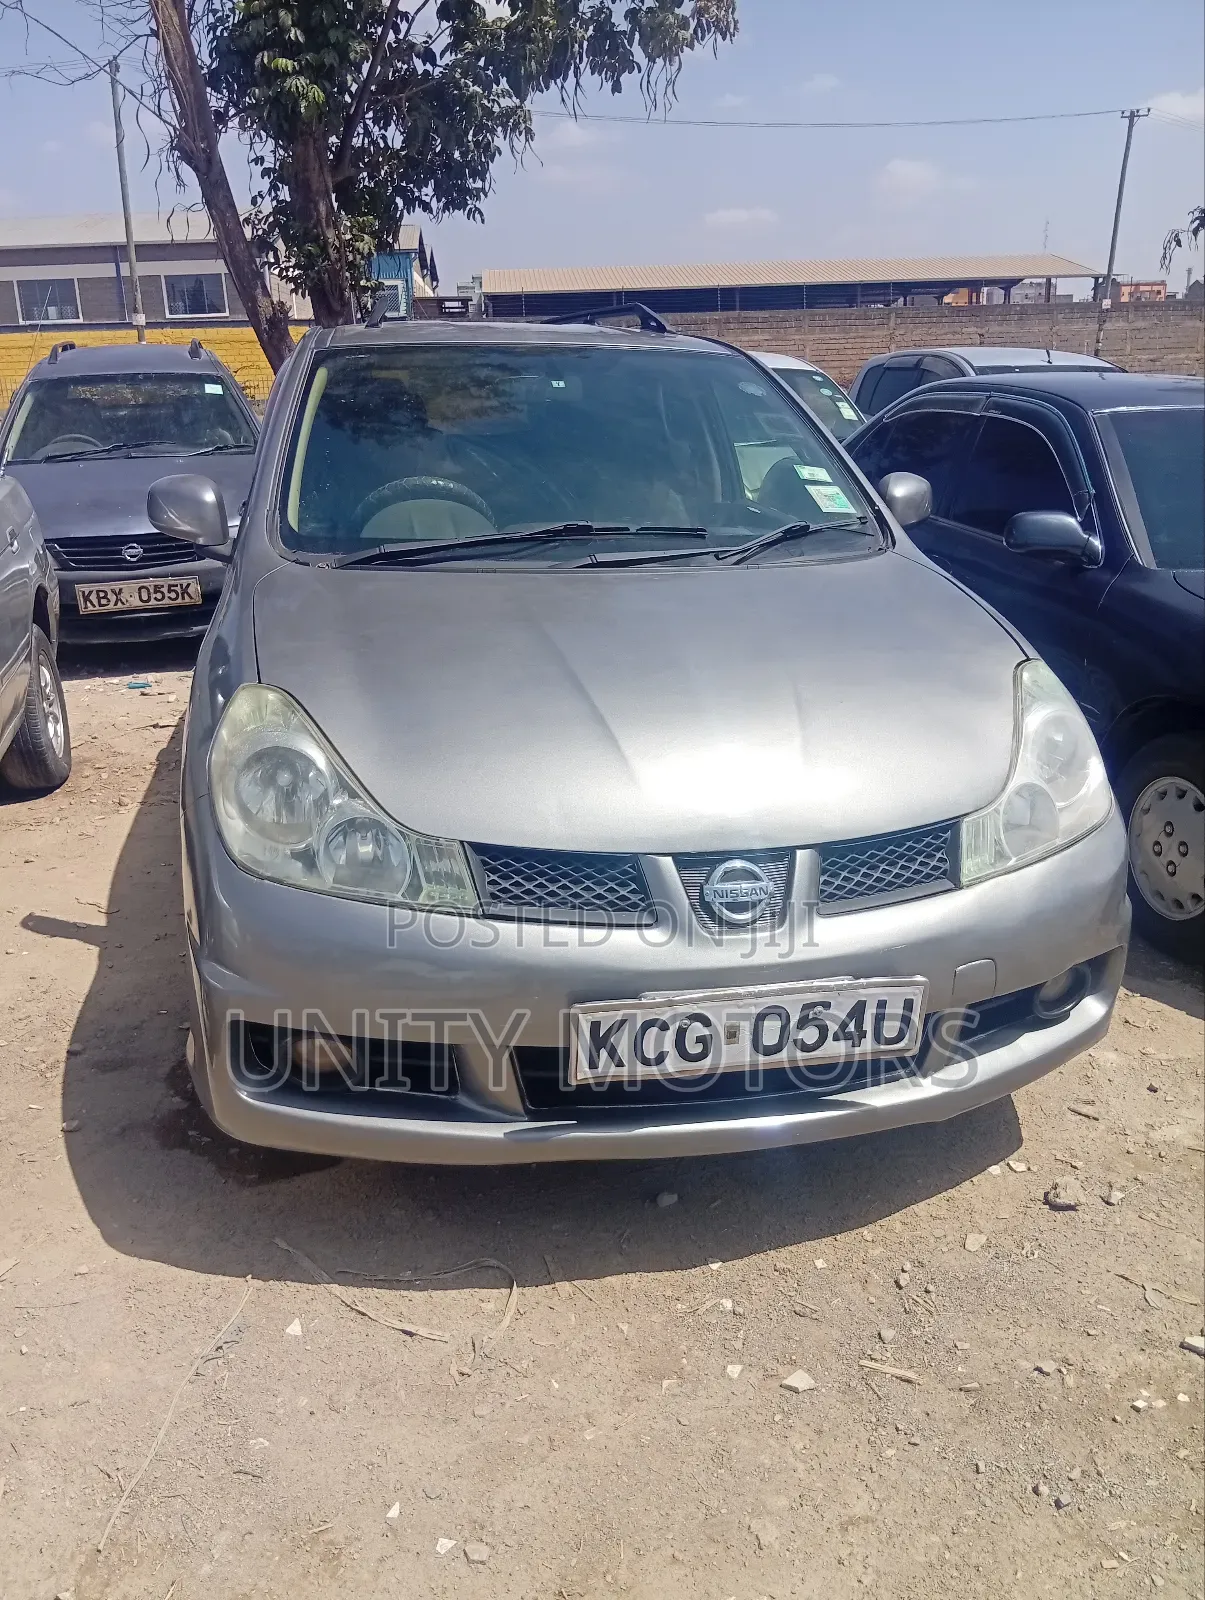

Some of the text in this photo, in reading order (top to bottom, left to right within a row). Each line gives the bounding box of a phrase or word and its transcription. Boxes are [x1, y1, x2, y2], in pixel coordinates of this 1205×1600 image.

[81, 583, 194, 610] KBX 055K
[713, 885, 769, 899] NISSAN
[588, 997, 915, 1070] KCG 054U
